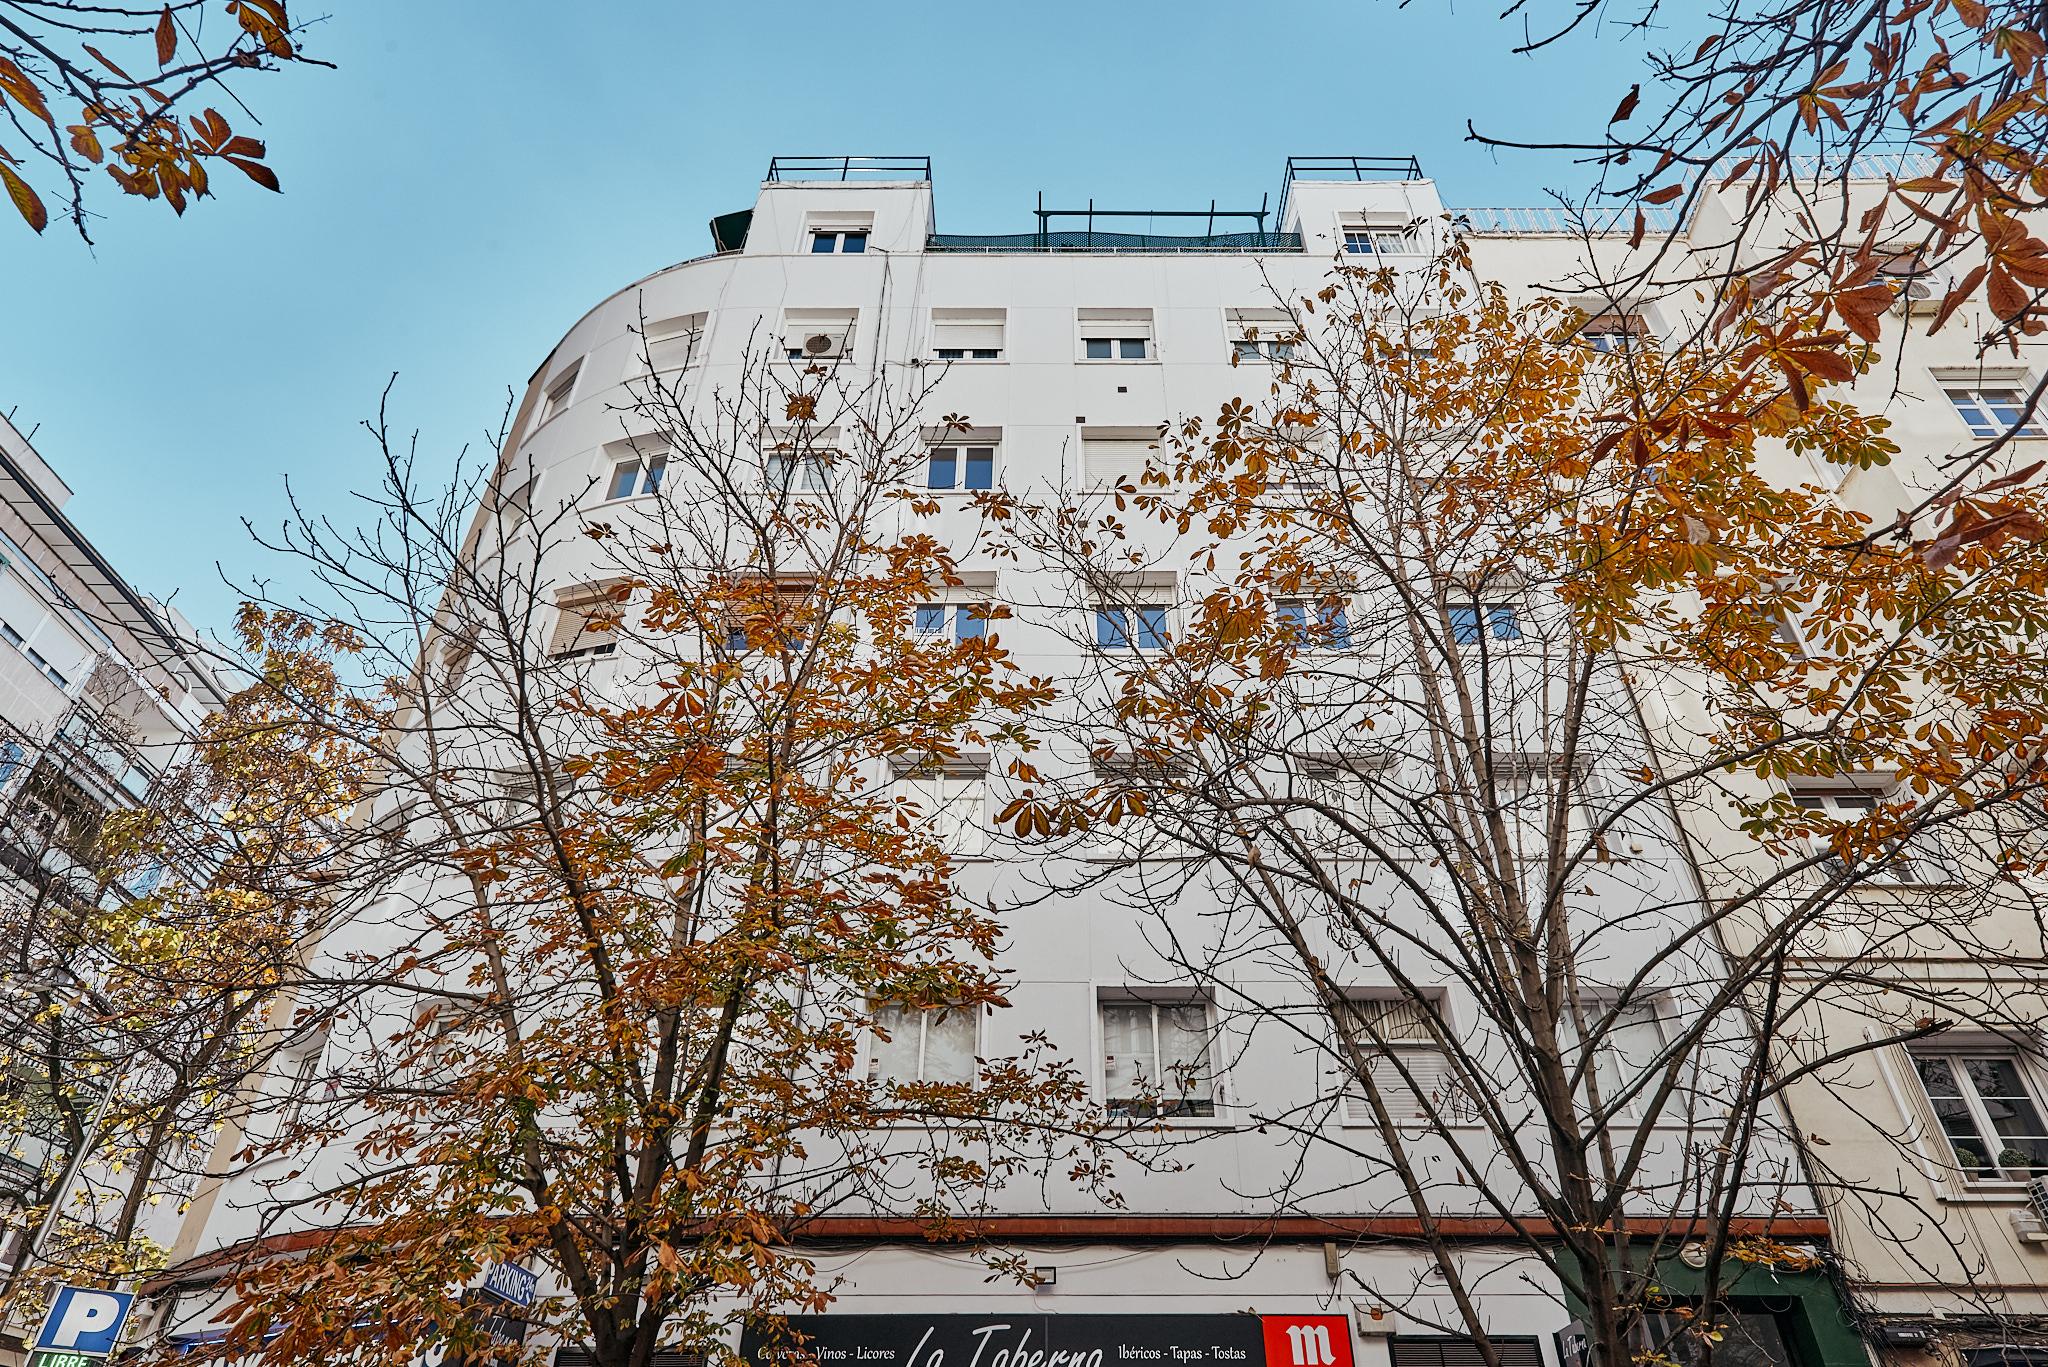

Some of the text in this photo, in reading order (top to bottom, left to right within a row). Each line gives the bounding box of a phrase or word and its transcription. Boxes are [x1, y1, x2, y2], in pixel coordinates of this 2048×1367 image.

[484, 1262, 527, 1301] PARKING
[51, 1291, 120, 1347] P
[39, 1353, 88, 1367] LIBRE
[815, 1346, 847, 1360] Vinos
[857, 1346, 896, 1360] Licores
[905, 1324, 1103, 1367] La Taberna
[1118, 1344, 1247, 1364] Ibéricos Tapas Tostas
